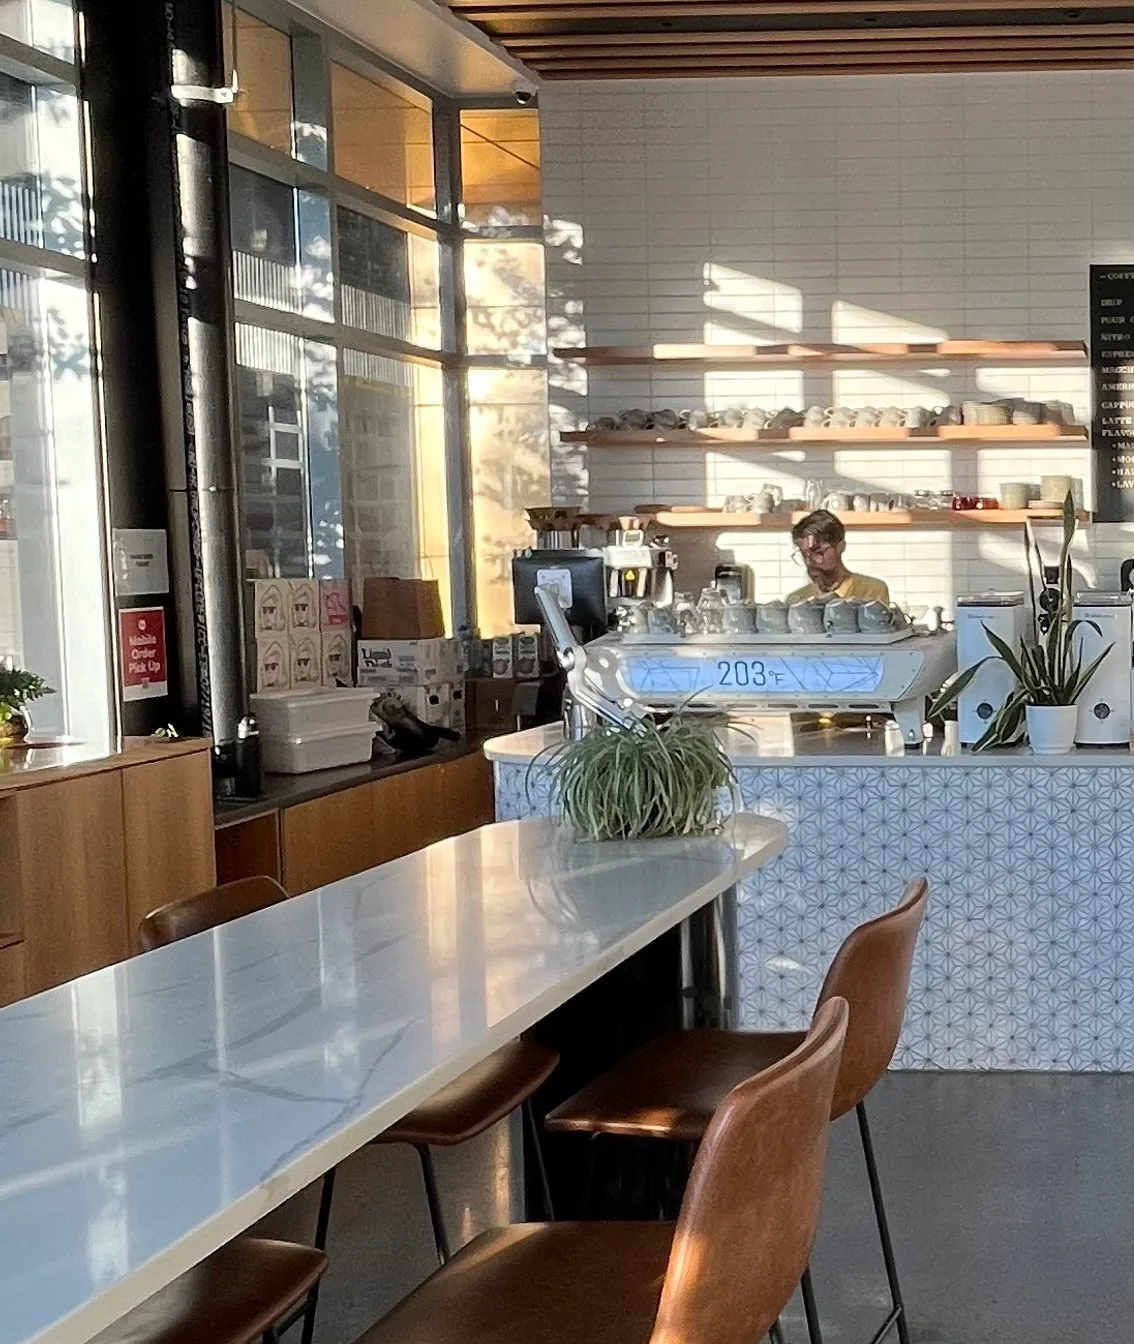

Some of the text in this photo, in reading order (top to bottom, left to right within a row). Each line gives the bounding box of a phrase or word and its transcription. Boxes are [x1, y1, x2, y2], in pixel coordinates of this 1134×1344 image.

[1100, 316, 1125, 324] POUR
[1101, 416, 1132, 425] LATTE
[129, 634, 157, 646] Mobile
[131, 647, 157, 660] Order
[128, 659, 161, 674] Pick Up
